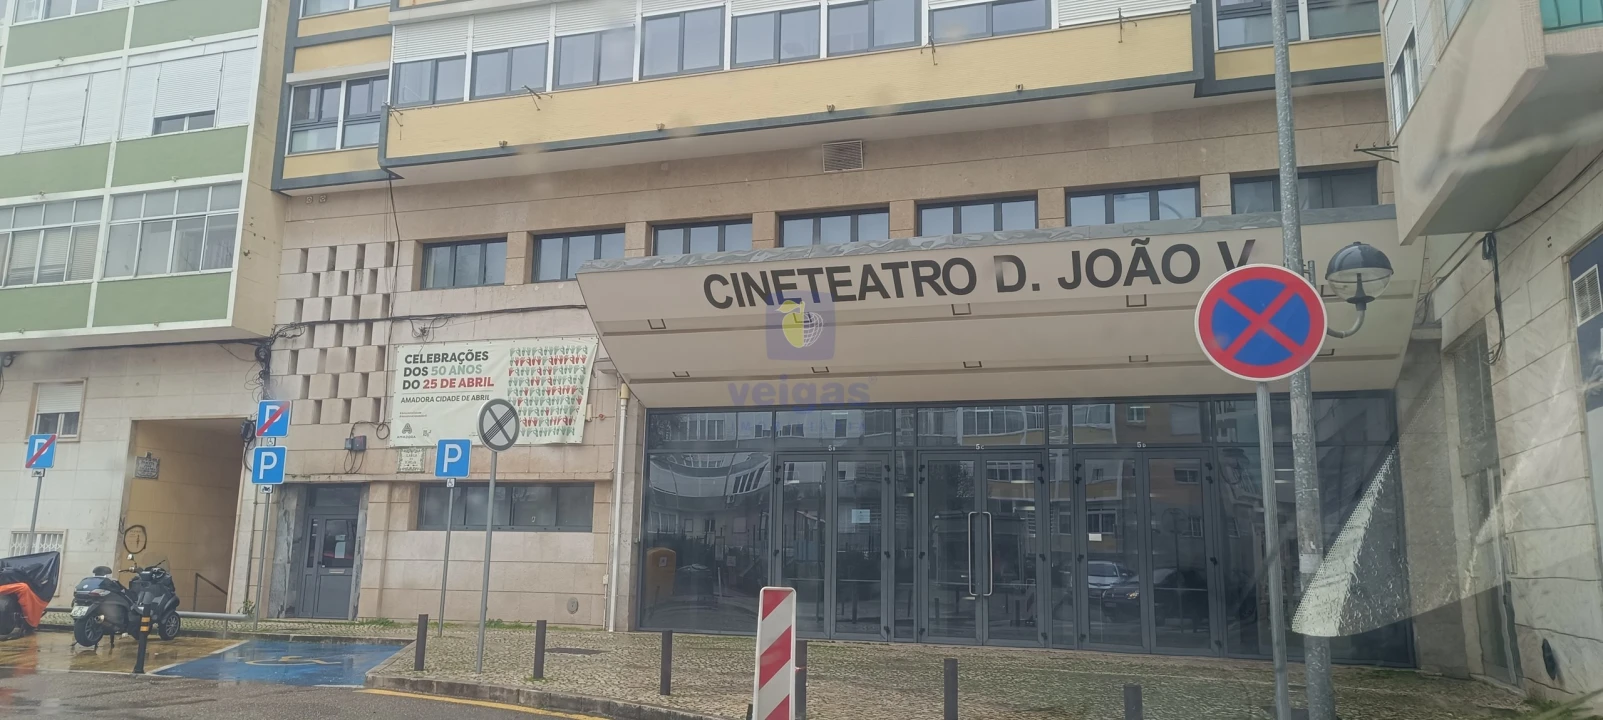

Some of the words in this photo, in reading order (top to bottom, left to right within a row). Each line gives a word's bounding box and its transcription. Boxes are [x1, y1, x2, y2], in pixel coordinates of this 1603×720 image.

[703, 257, 977, 310] CINETEATRO
[993, 254, 1041, 293] D.
[1057, 237, 1201, 290] JOÃO
[1216, 239, 1256, 272] V
[404, 349, 489, 364] CELEBRAÇÕES
[403, 366, 429, 377] DOS
[431, 366, 446, 376] 50
[449, 364, 483, 375] ANOS
[402, 380, 420, 390] DO
[422, 379, 438, 389] 25
[440, 378, 456, 388] DE
[458, 376, 495, 388] ABRIL
[401, 396, 435, 404] AMADORA
[461, 394, 470, 402] DE
[259, 451, 278, 480] P
[442, 443, 462, 473] P
